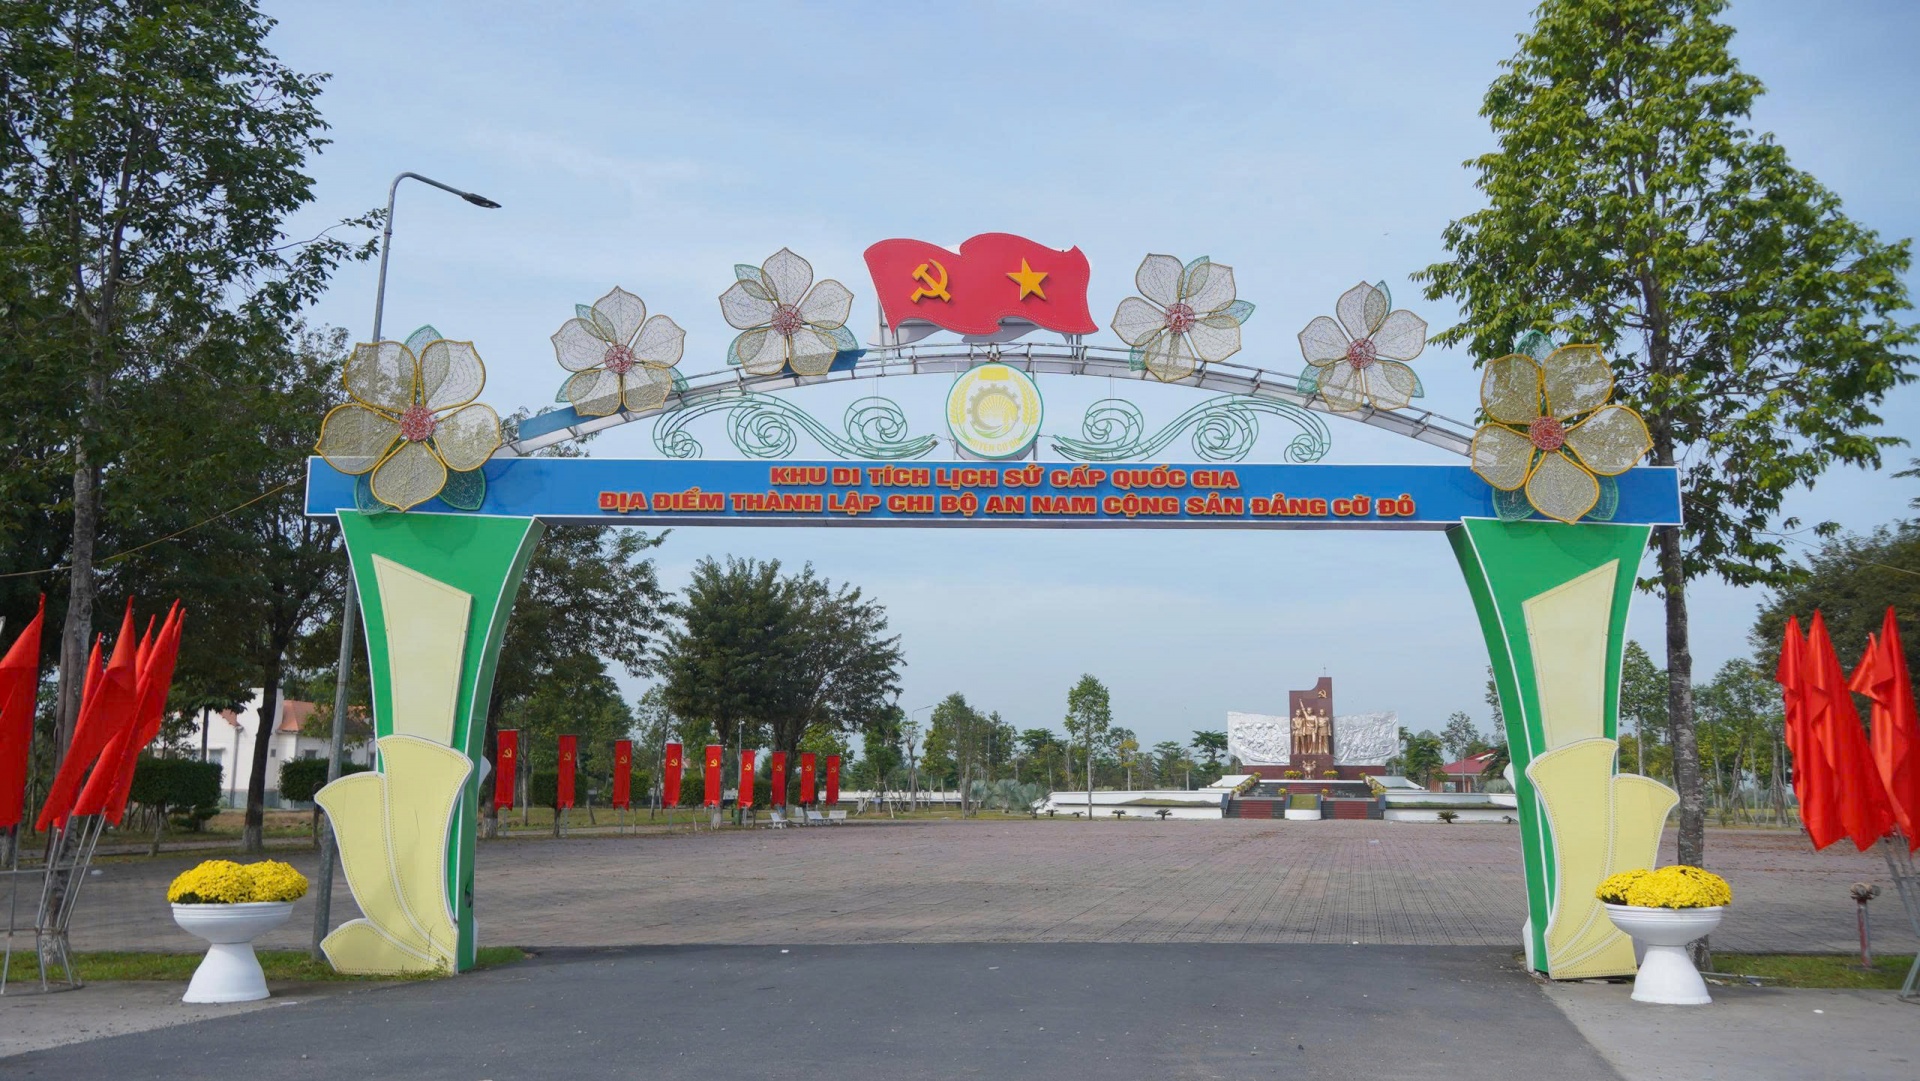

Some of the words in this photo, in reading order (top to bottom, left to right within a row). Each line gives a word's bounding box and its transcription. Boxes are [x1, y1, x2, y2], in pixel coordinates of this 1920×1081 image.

[770, 466, 827, 485] KHU
[832, 467, 861, 485] DI
[867, 465, 930, 486] TÍCH
[936, 468, 998, 490] LỊCH
[1003, 464, 1044, 487] SỬ
[1050, 464, 1106, 488] CẤP
[1111, 464, 1187, 490] QUỐC
[1191, 470, 1239, 488] GIA
[598, 491, 648, 513] ĐỊA
[651, 487, 725, 511] ĐIỂM
[729, 490, 823, 512] THÀNH
[828, 491, 881, 515] LẬP
[887, 494, 934, 513] CHI
[940, 492, 978, 516] BỘ
[984, 495, 1026, 513] AN
[1031, 496, 1098, 514] NAM
[1102, 493, 1180, 517] CỘNG
[1185, 493, 1244, 515] SẢN
[1249, 493, 1328, 516] ĐẢNG
[1331, 494, 1370, 516] CỜ
[1376, 493, 1415, 516] ĐỎ
